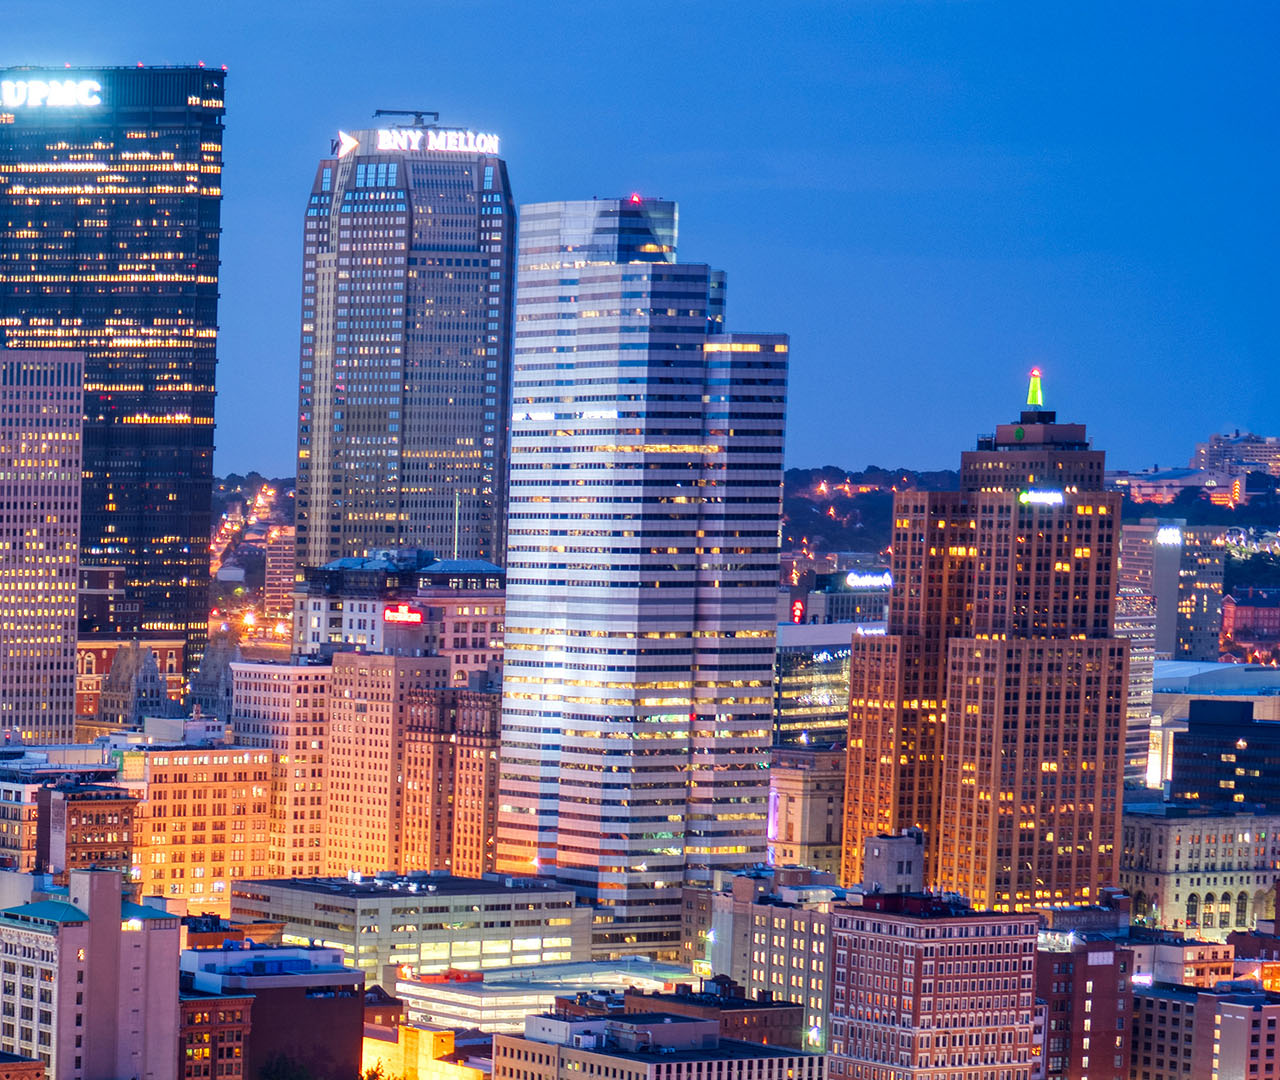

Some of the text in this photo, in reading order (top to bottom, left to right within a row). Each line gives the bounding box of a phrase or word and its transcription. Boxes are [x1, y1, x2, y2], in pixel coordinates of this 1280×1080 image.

[1, 80, 101, 106] UPMC
[377, 129, 499, 154] BNY MELLON
